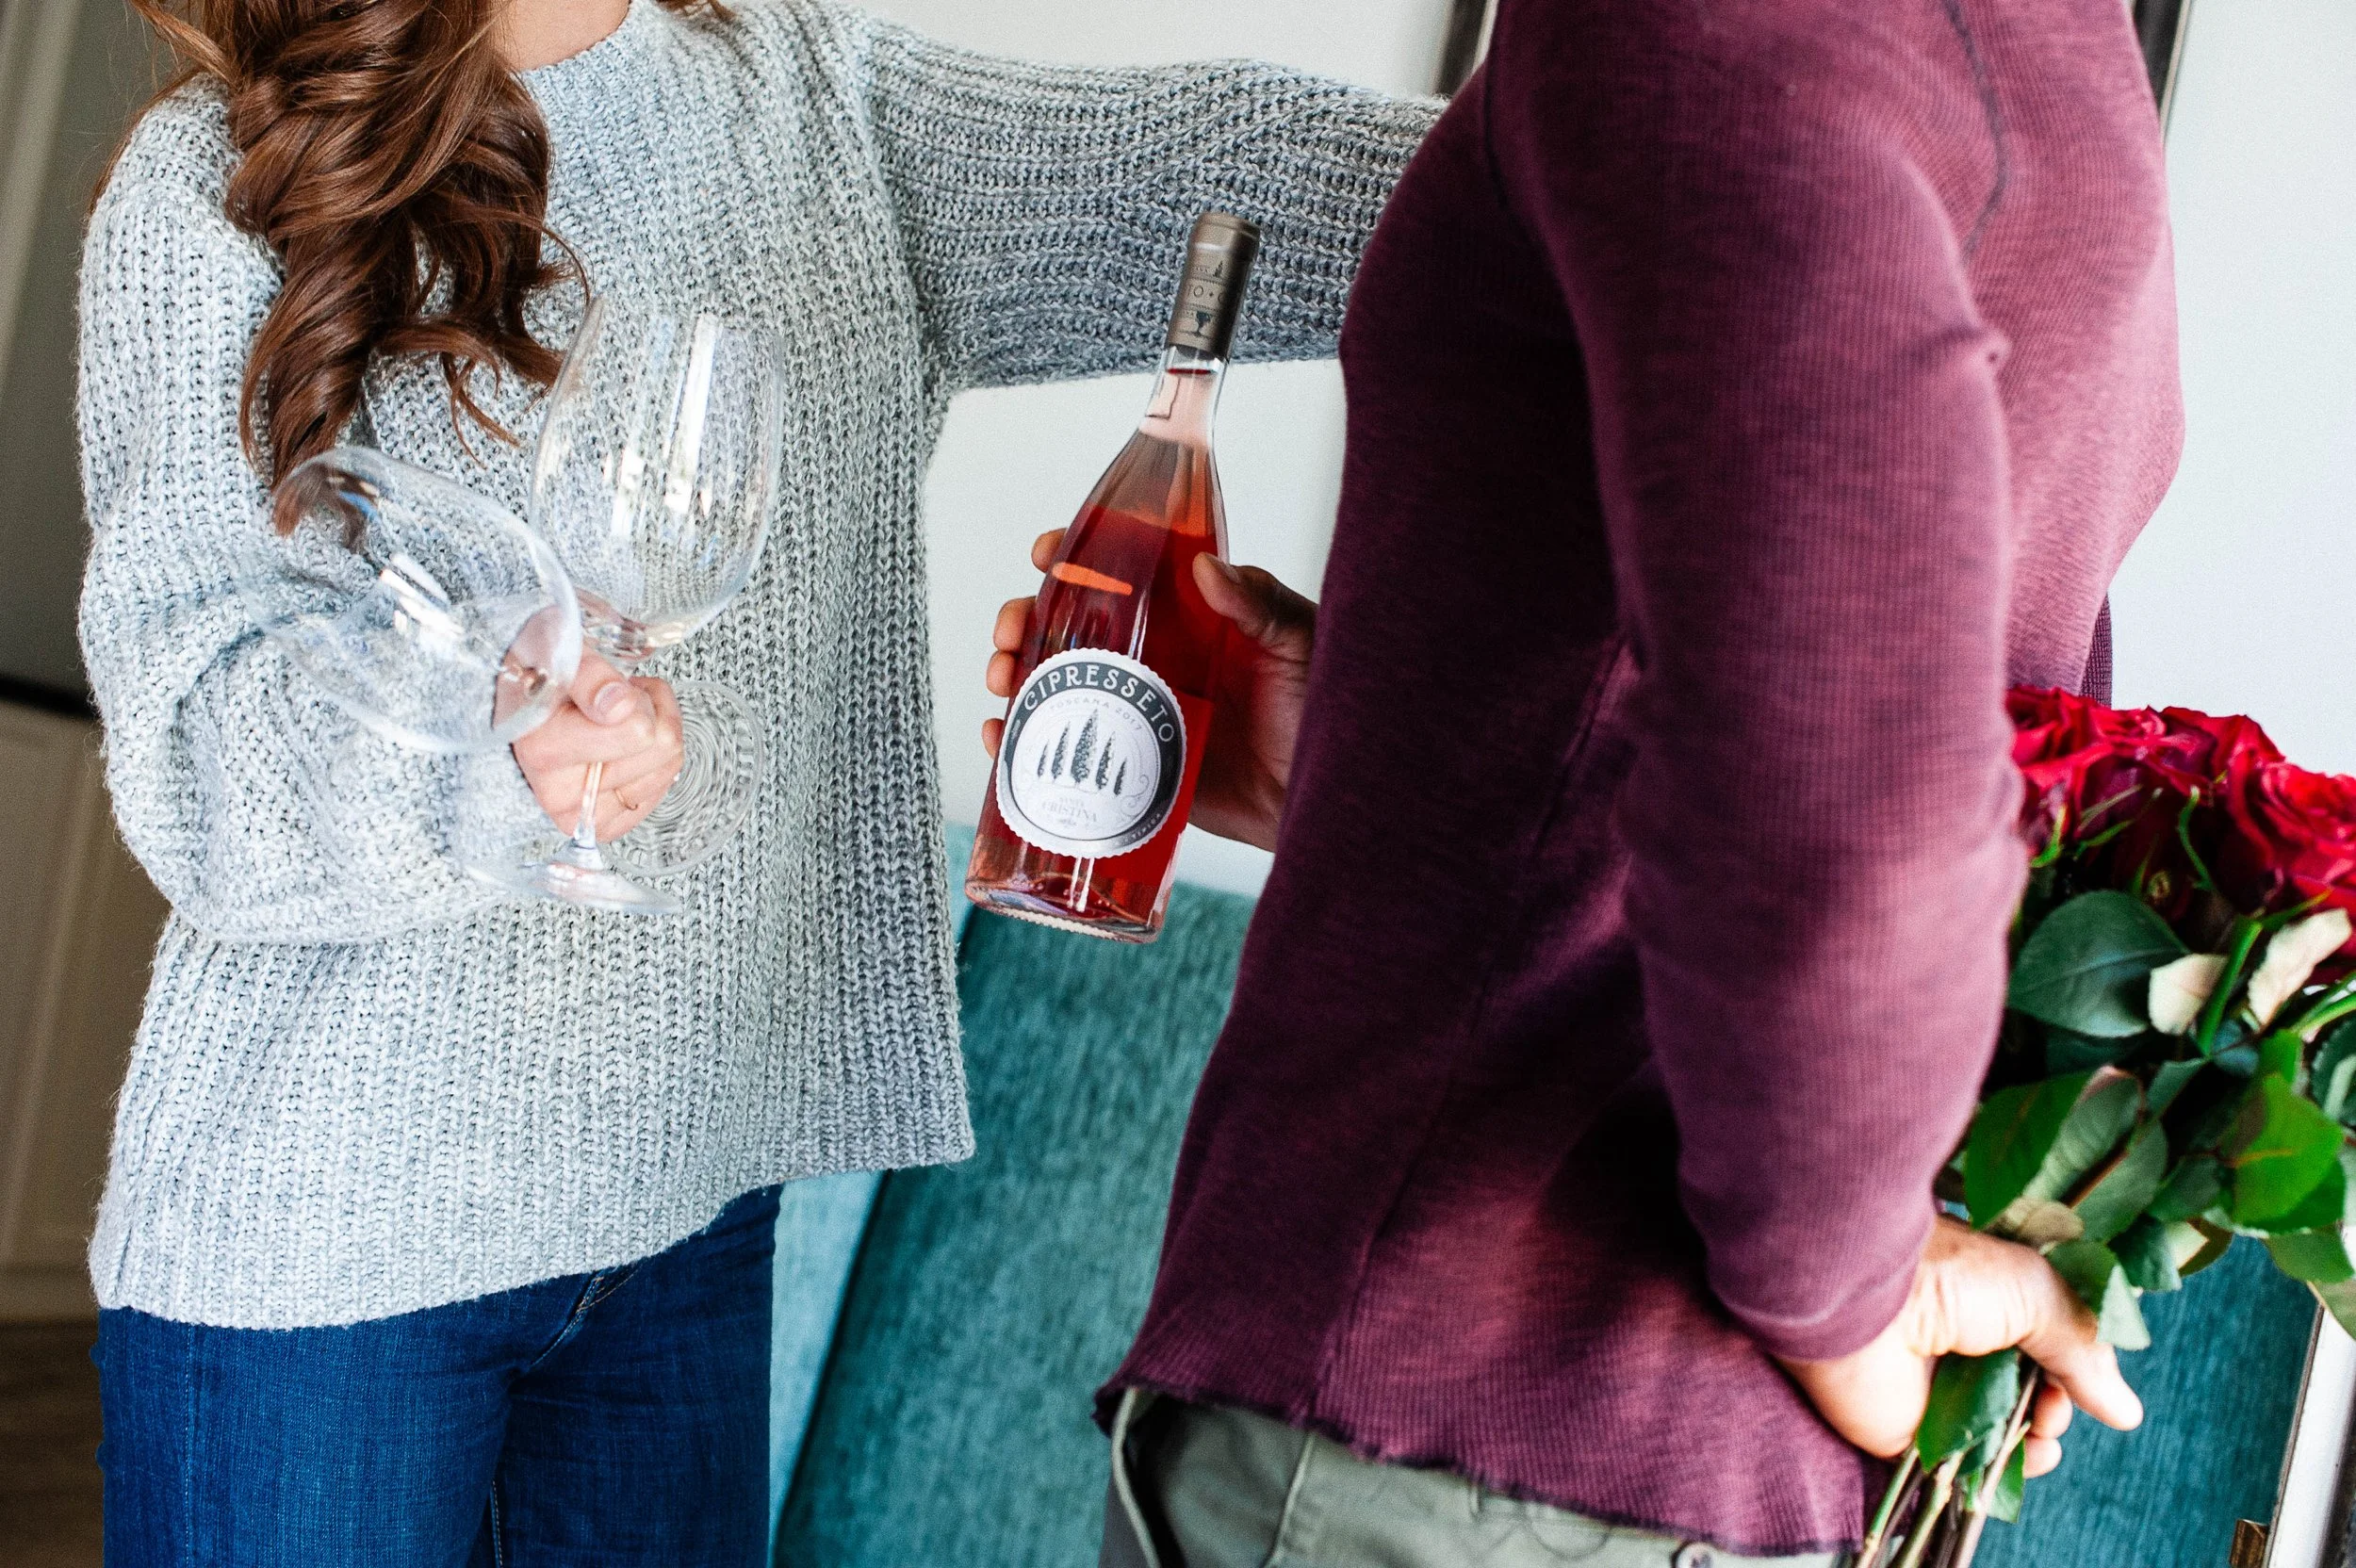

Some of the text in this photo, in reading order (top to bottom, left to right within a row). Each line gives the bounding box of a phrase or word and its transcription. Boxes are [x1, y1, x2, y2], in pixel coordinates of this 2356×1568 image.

[1023, 663, 1175, 743] CIPRESSETO
[1050, 696, 1143, 731] TOSCANA 2017
